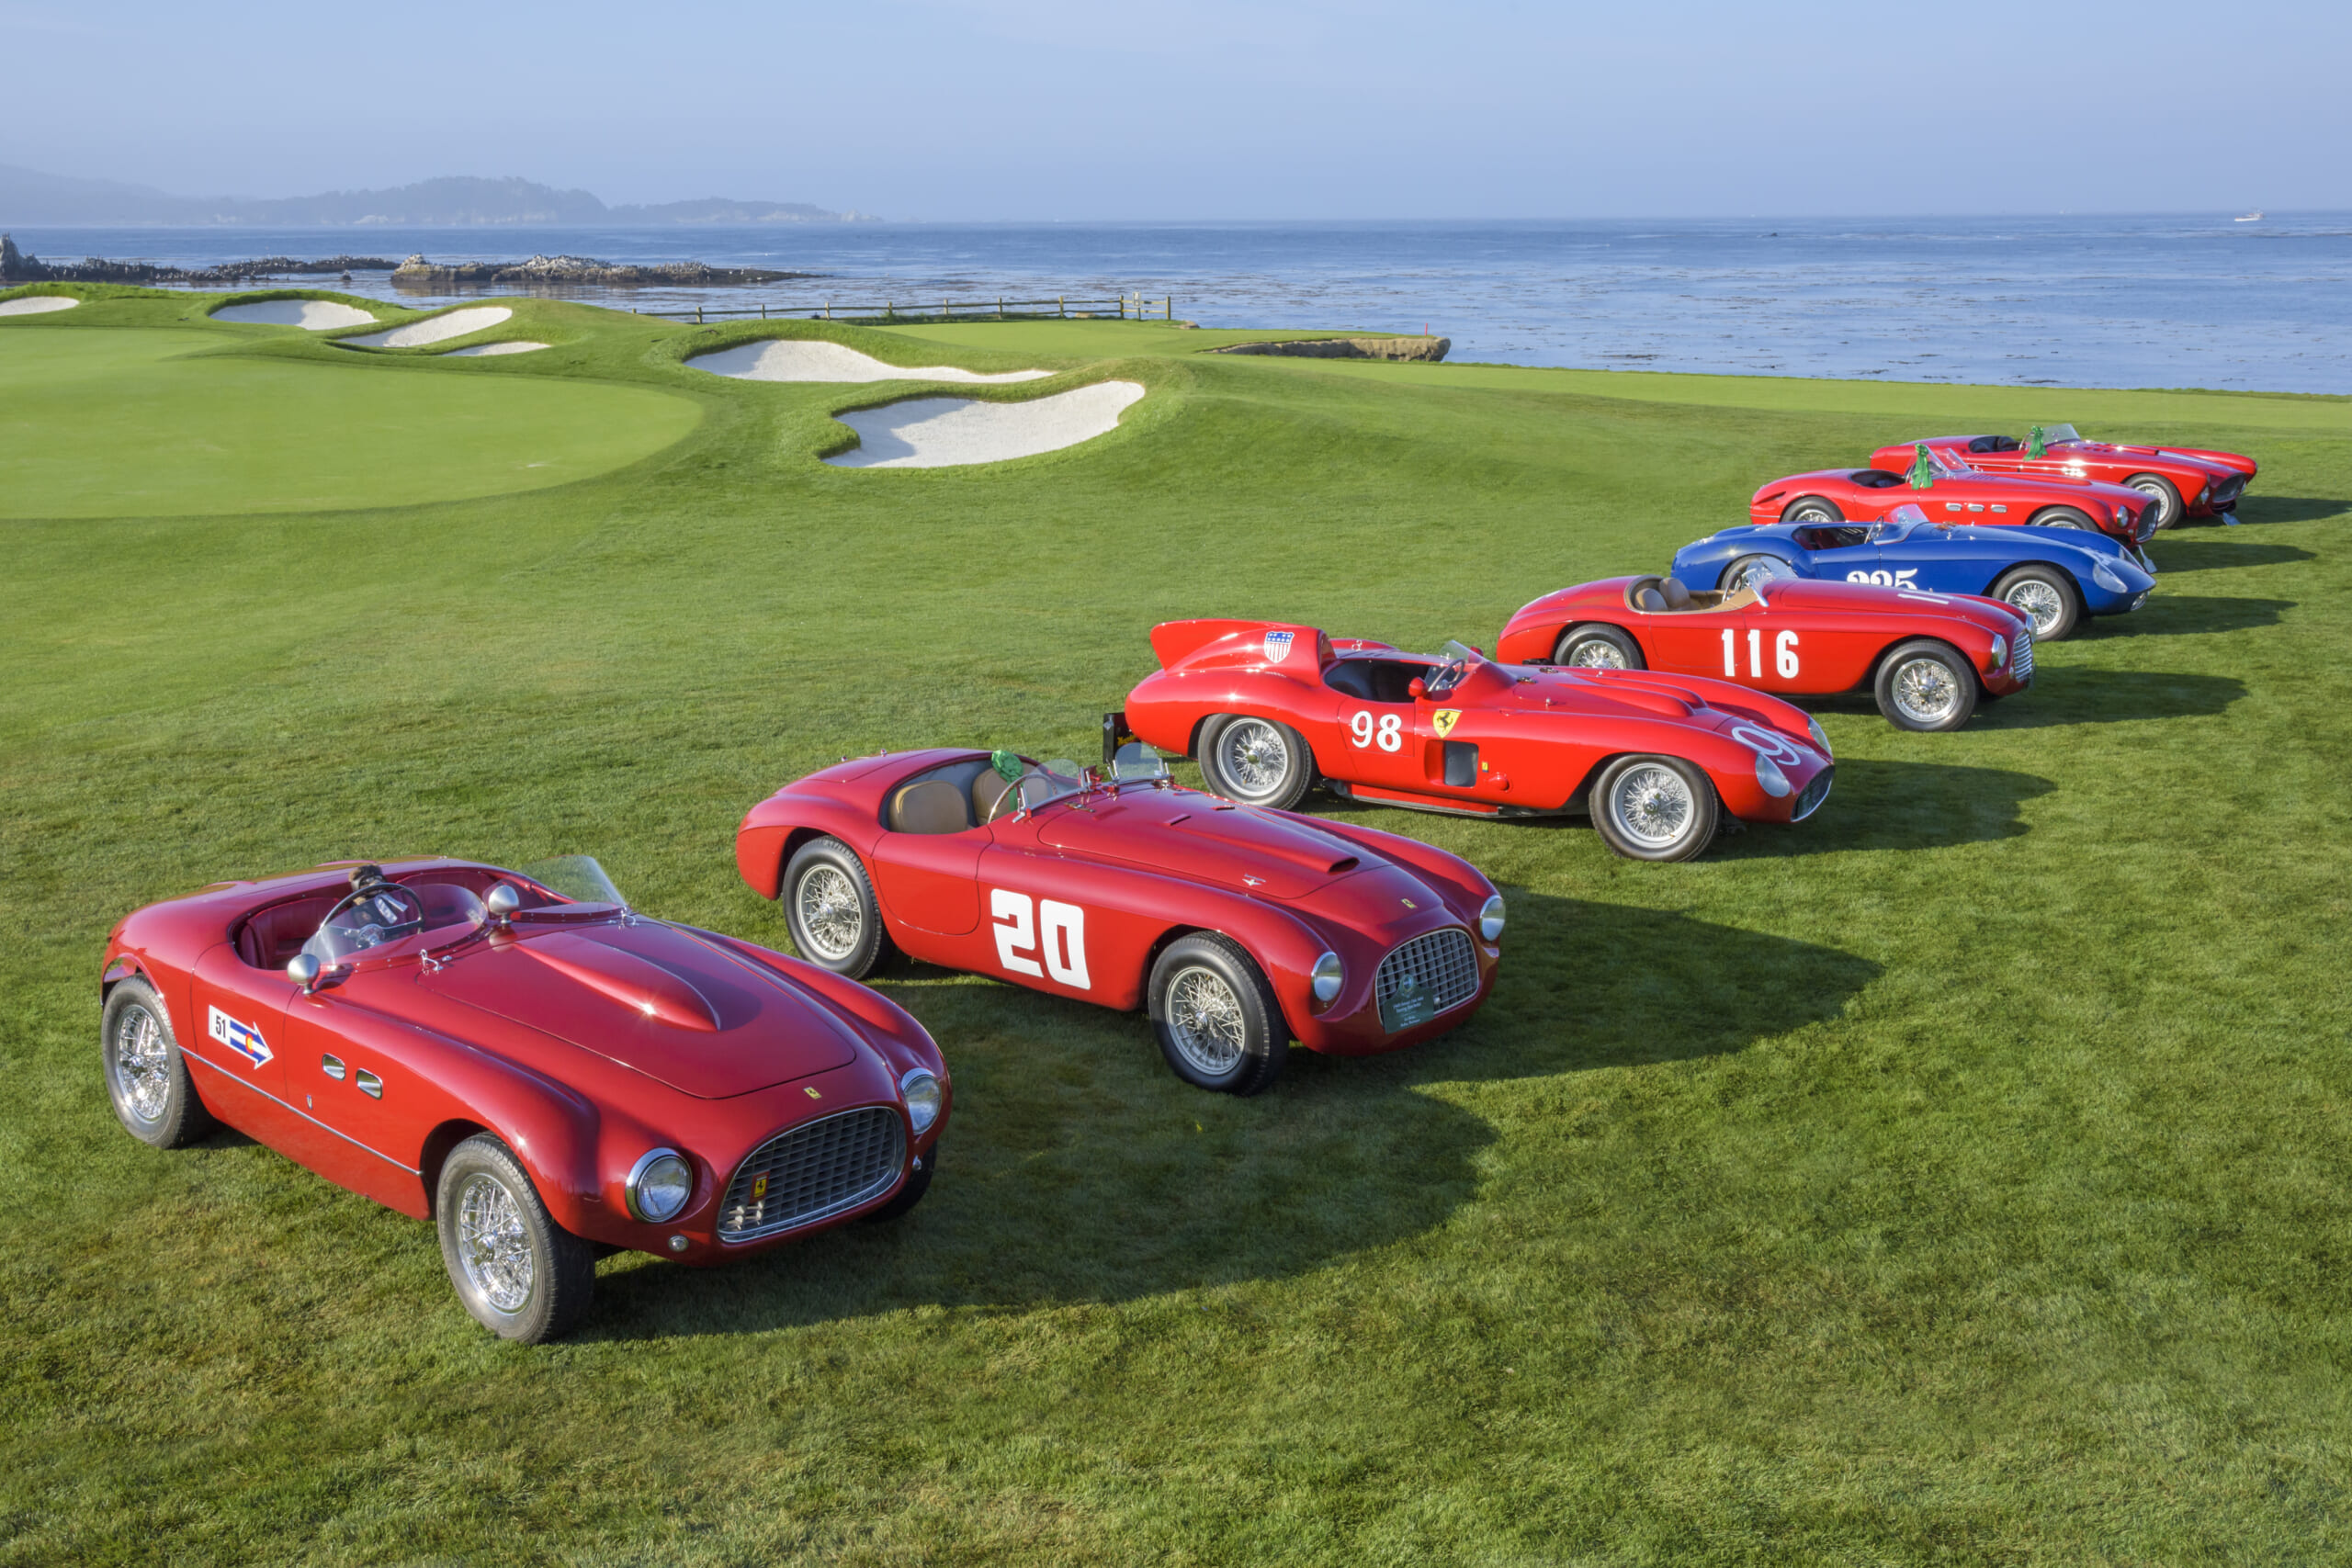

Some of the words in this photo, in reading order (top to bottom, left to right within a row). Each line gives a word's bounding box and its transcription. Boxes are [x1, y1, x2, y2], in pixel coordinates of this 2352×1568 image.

[1721, 628, 1800, 679] 116
[1351, 710, 1402, 752] 98
[1731, 720, 1815, 766] 9
[990, 888, 1091, 990] 20
[215, 1014, 227, 1039] 51
